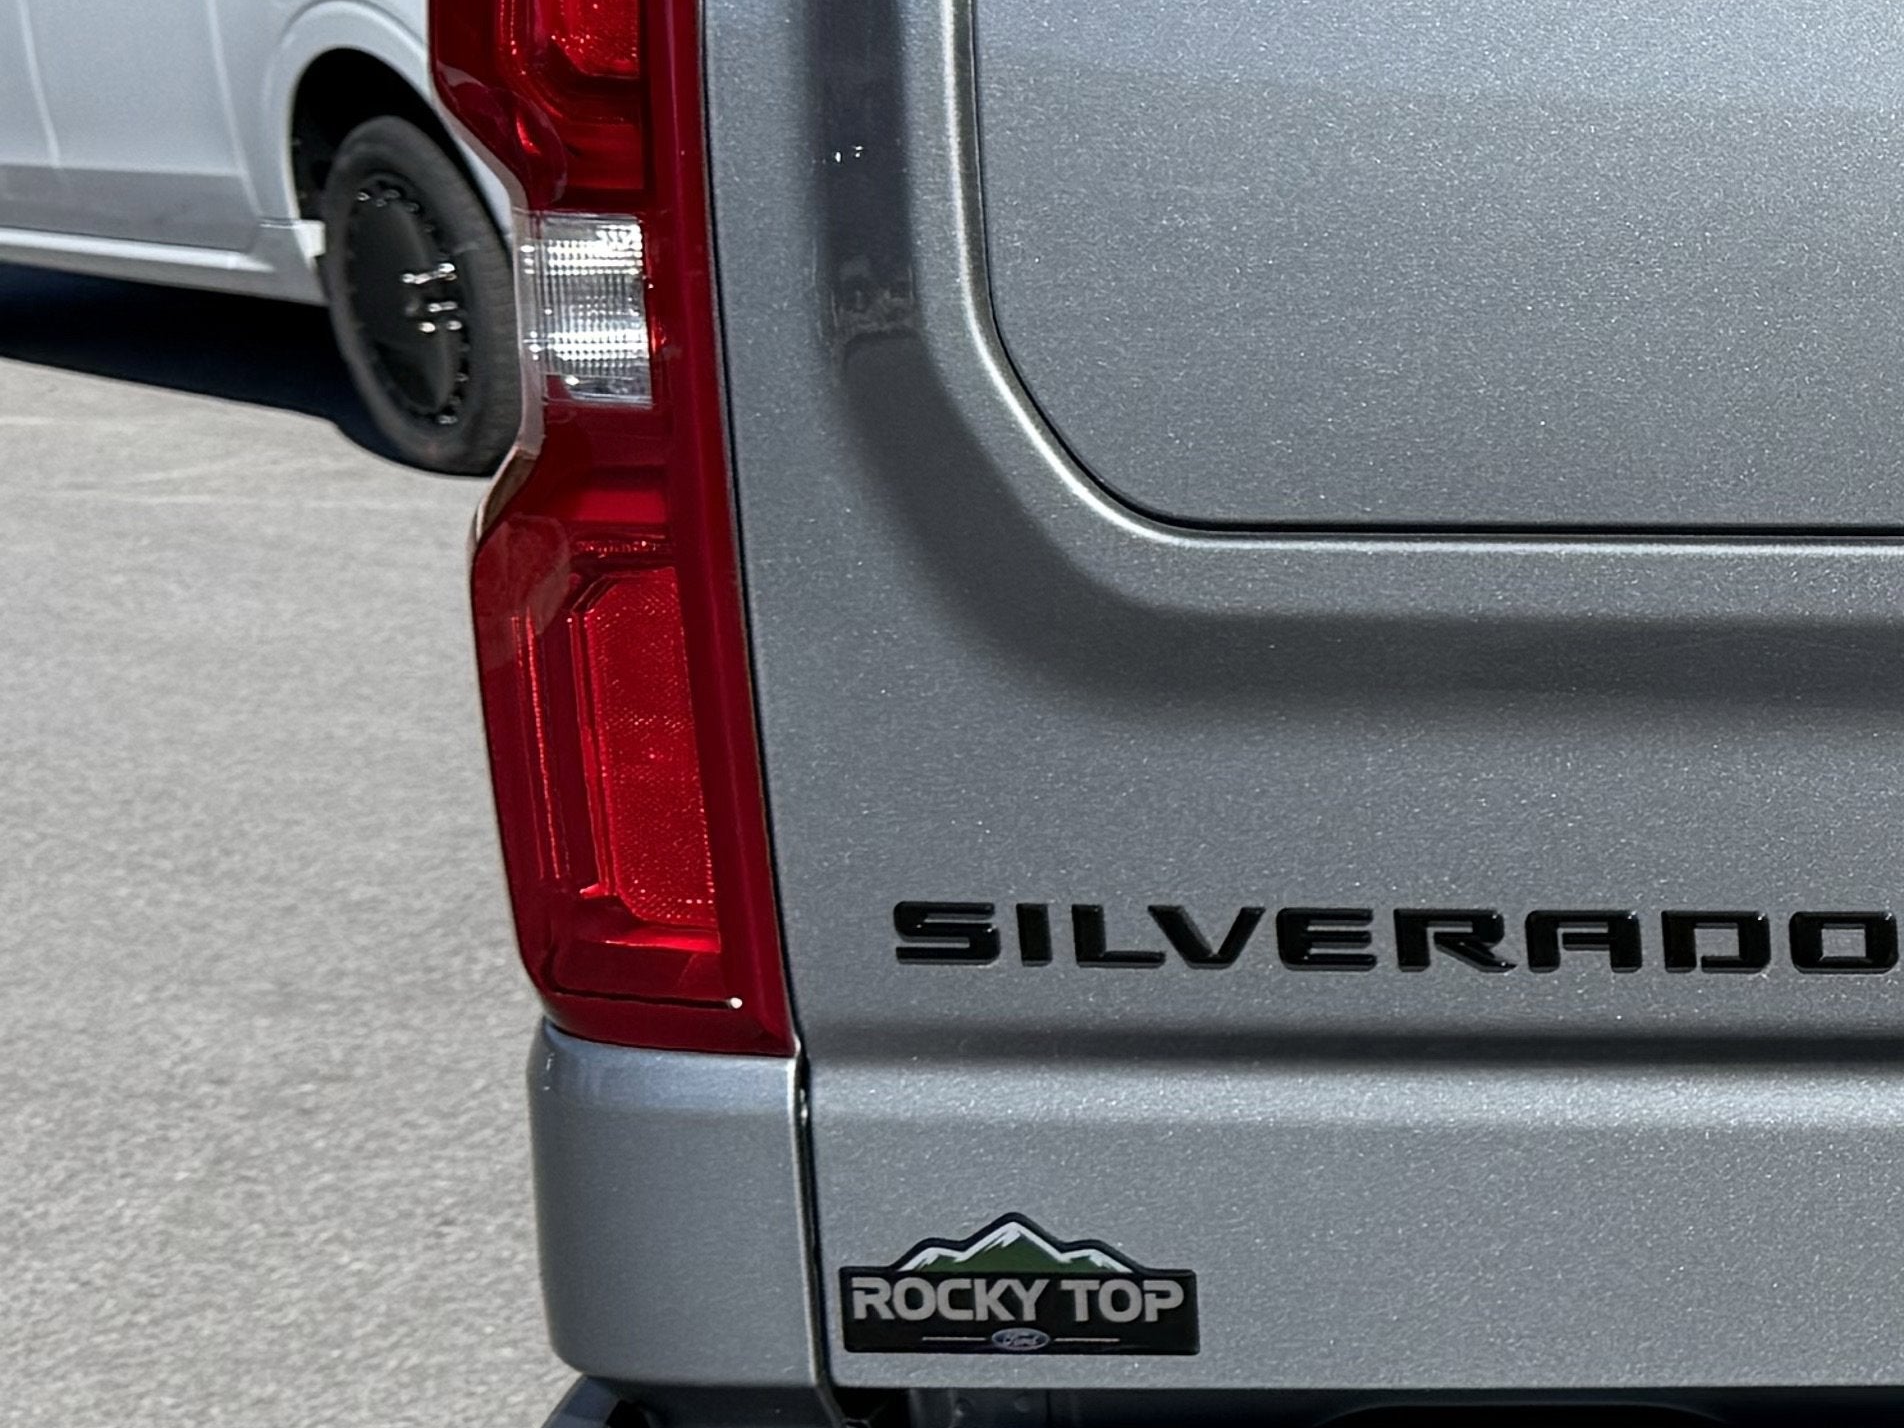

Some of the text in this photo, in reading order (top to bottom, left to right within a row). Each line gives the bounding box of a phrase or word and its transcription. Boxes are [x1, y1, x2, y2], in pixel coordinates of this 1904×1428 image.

[894, 901, 1898, 972] SILVERADO
[852, 1277, 1184, 1322] ROCKY TOP
